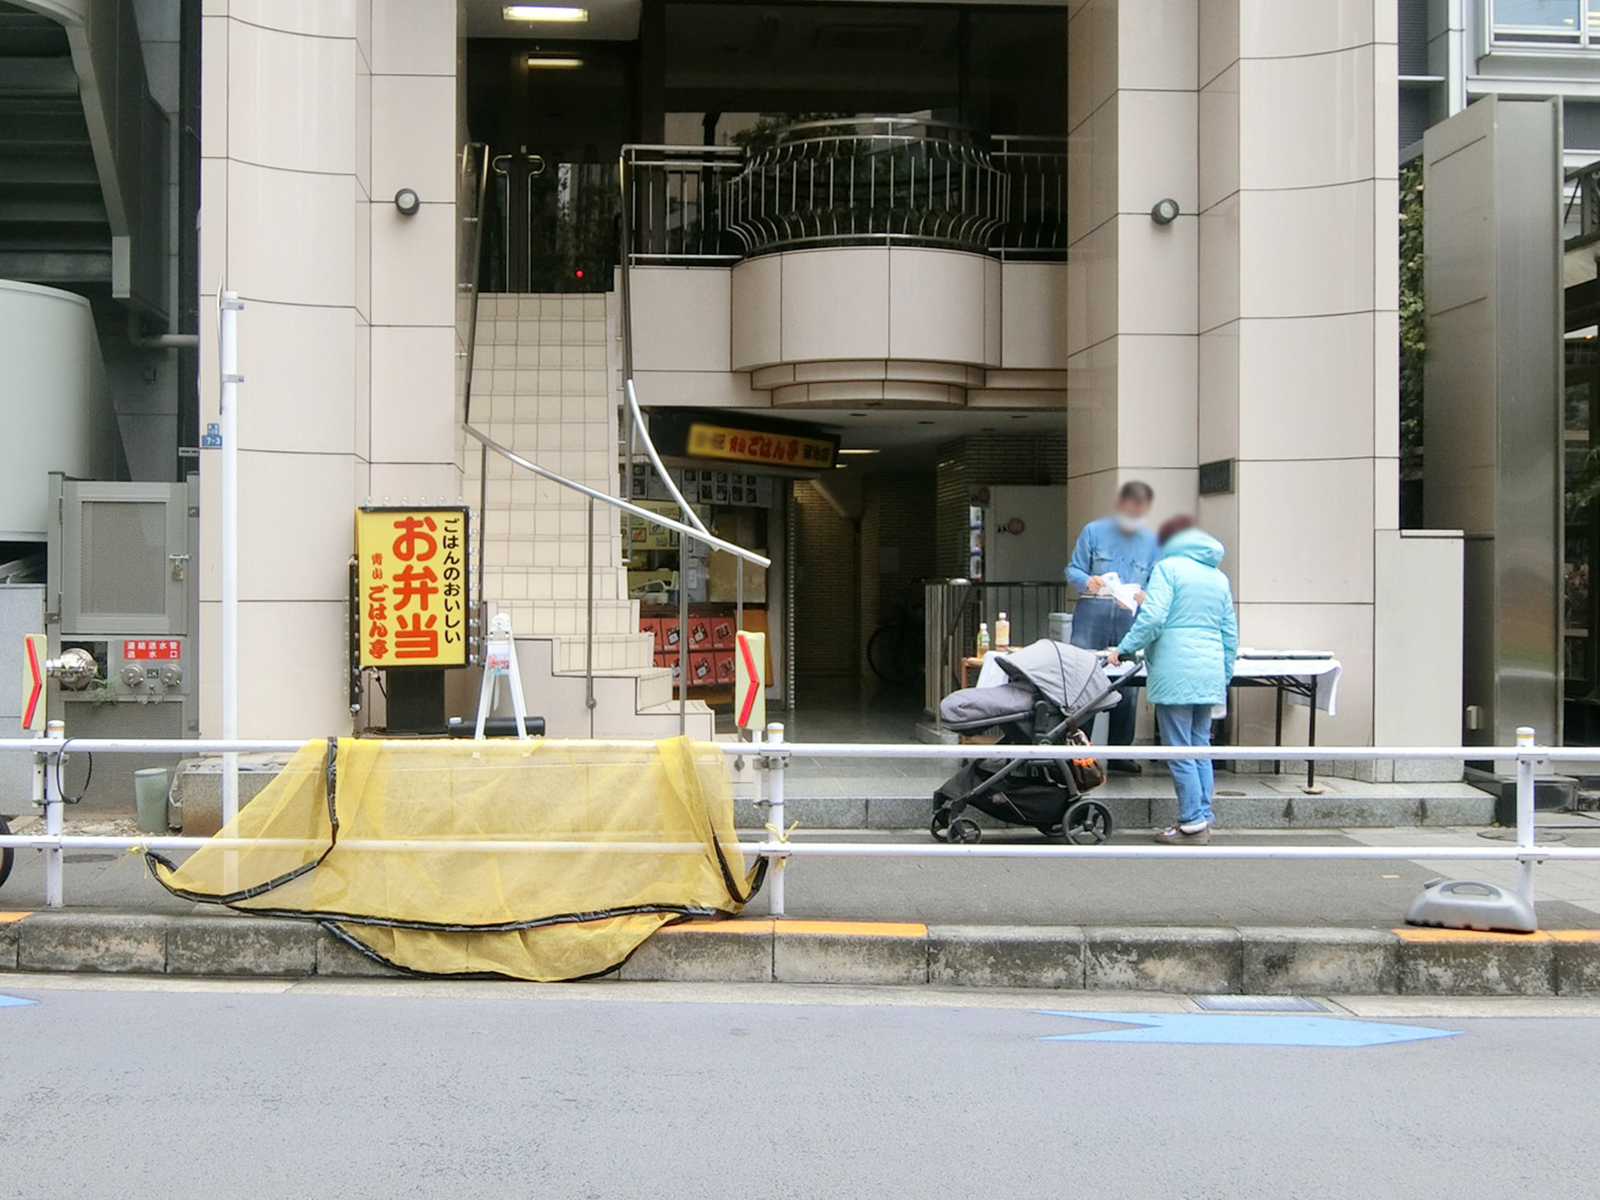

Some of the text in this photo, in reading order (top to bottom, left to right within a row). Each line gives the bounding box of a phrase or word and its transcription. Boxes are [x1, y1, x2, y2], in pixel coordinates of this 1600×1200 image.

[392, 516, 439, 659] お弁当
[442, 518, 461, 644] ごはんのおいしい
